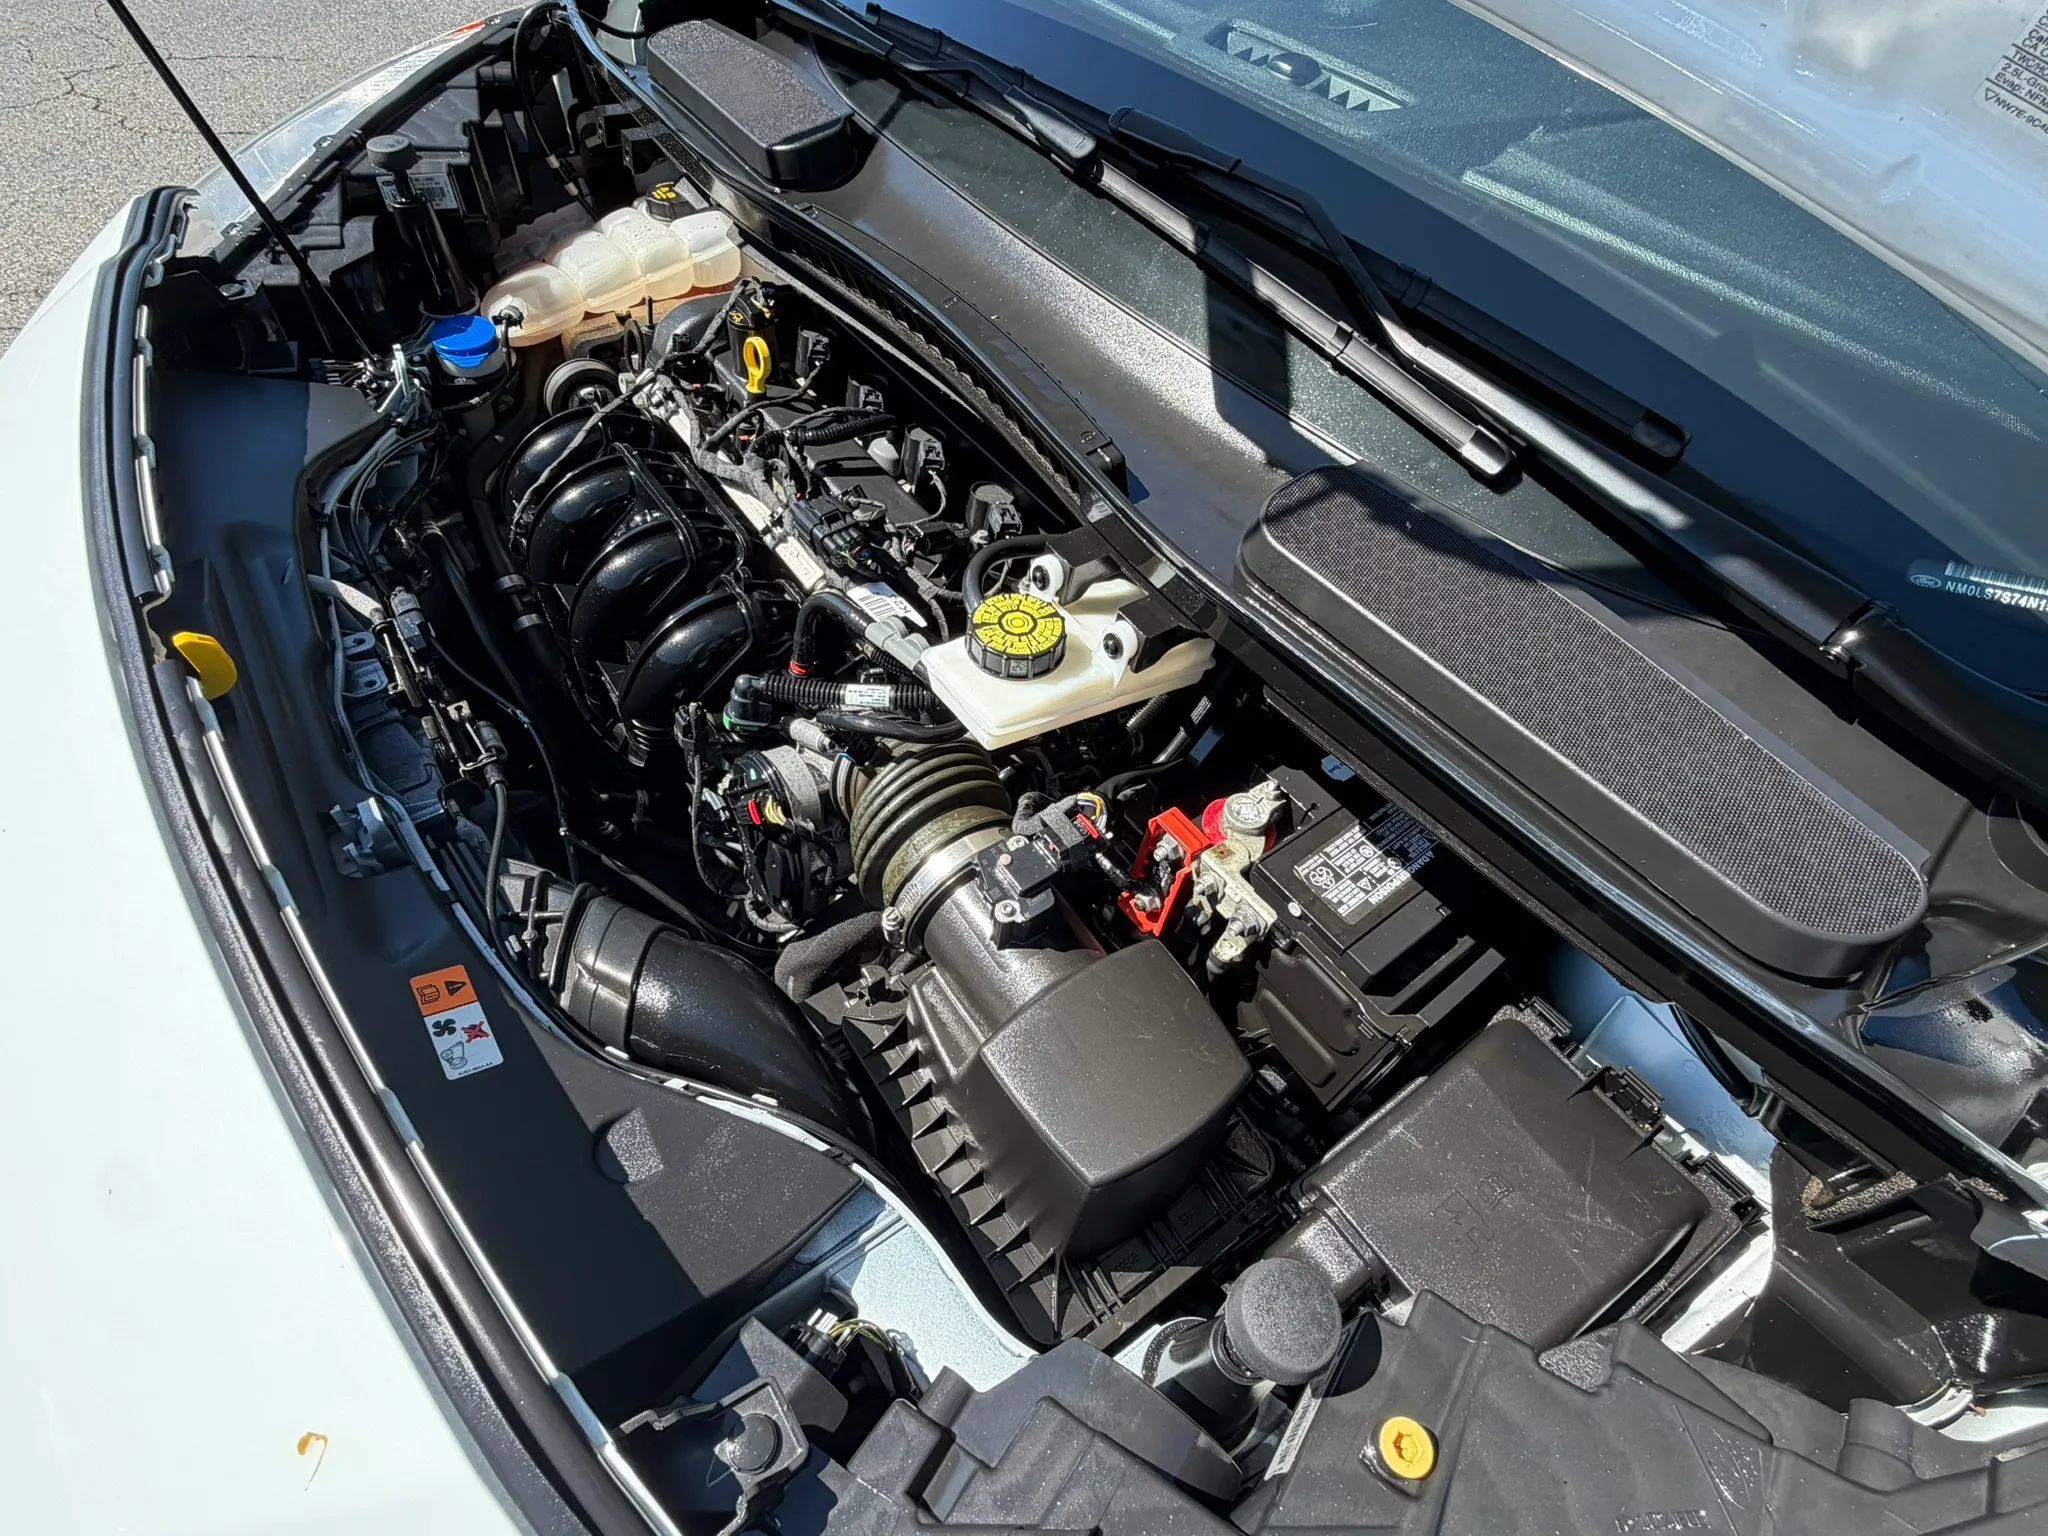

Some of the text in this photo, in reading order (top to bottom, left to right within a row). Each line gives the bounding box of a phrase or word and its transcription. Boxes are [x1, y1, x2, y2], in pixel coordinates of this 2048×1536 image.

[2021, 37, 2039, 52] CA
[1994, 72, 2025, 94] Evap:
[1367, 853, 1430, 905] DANGER/POISON
